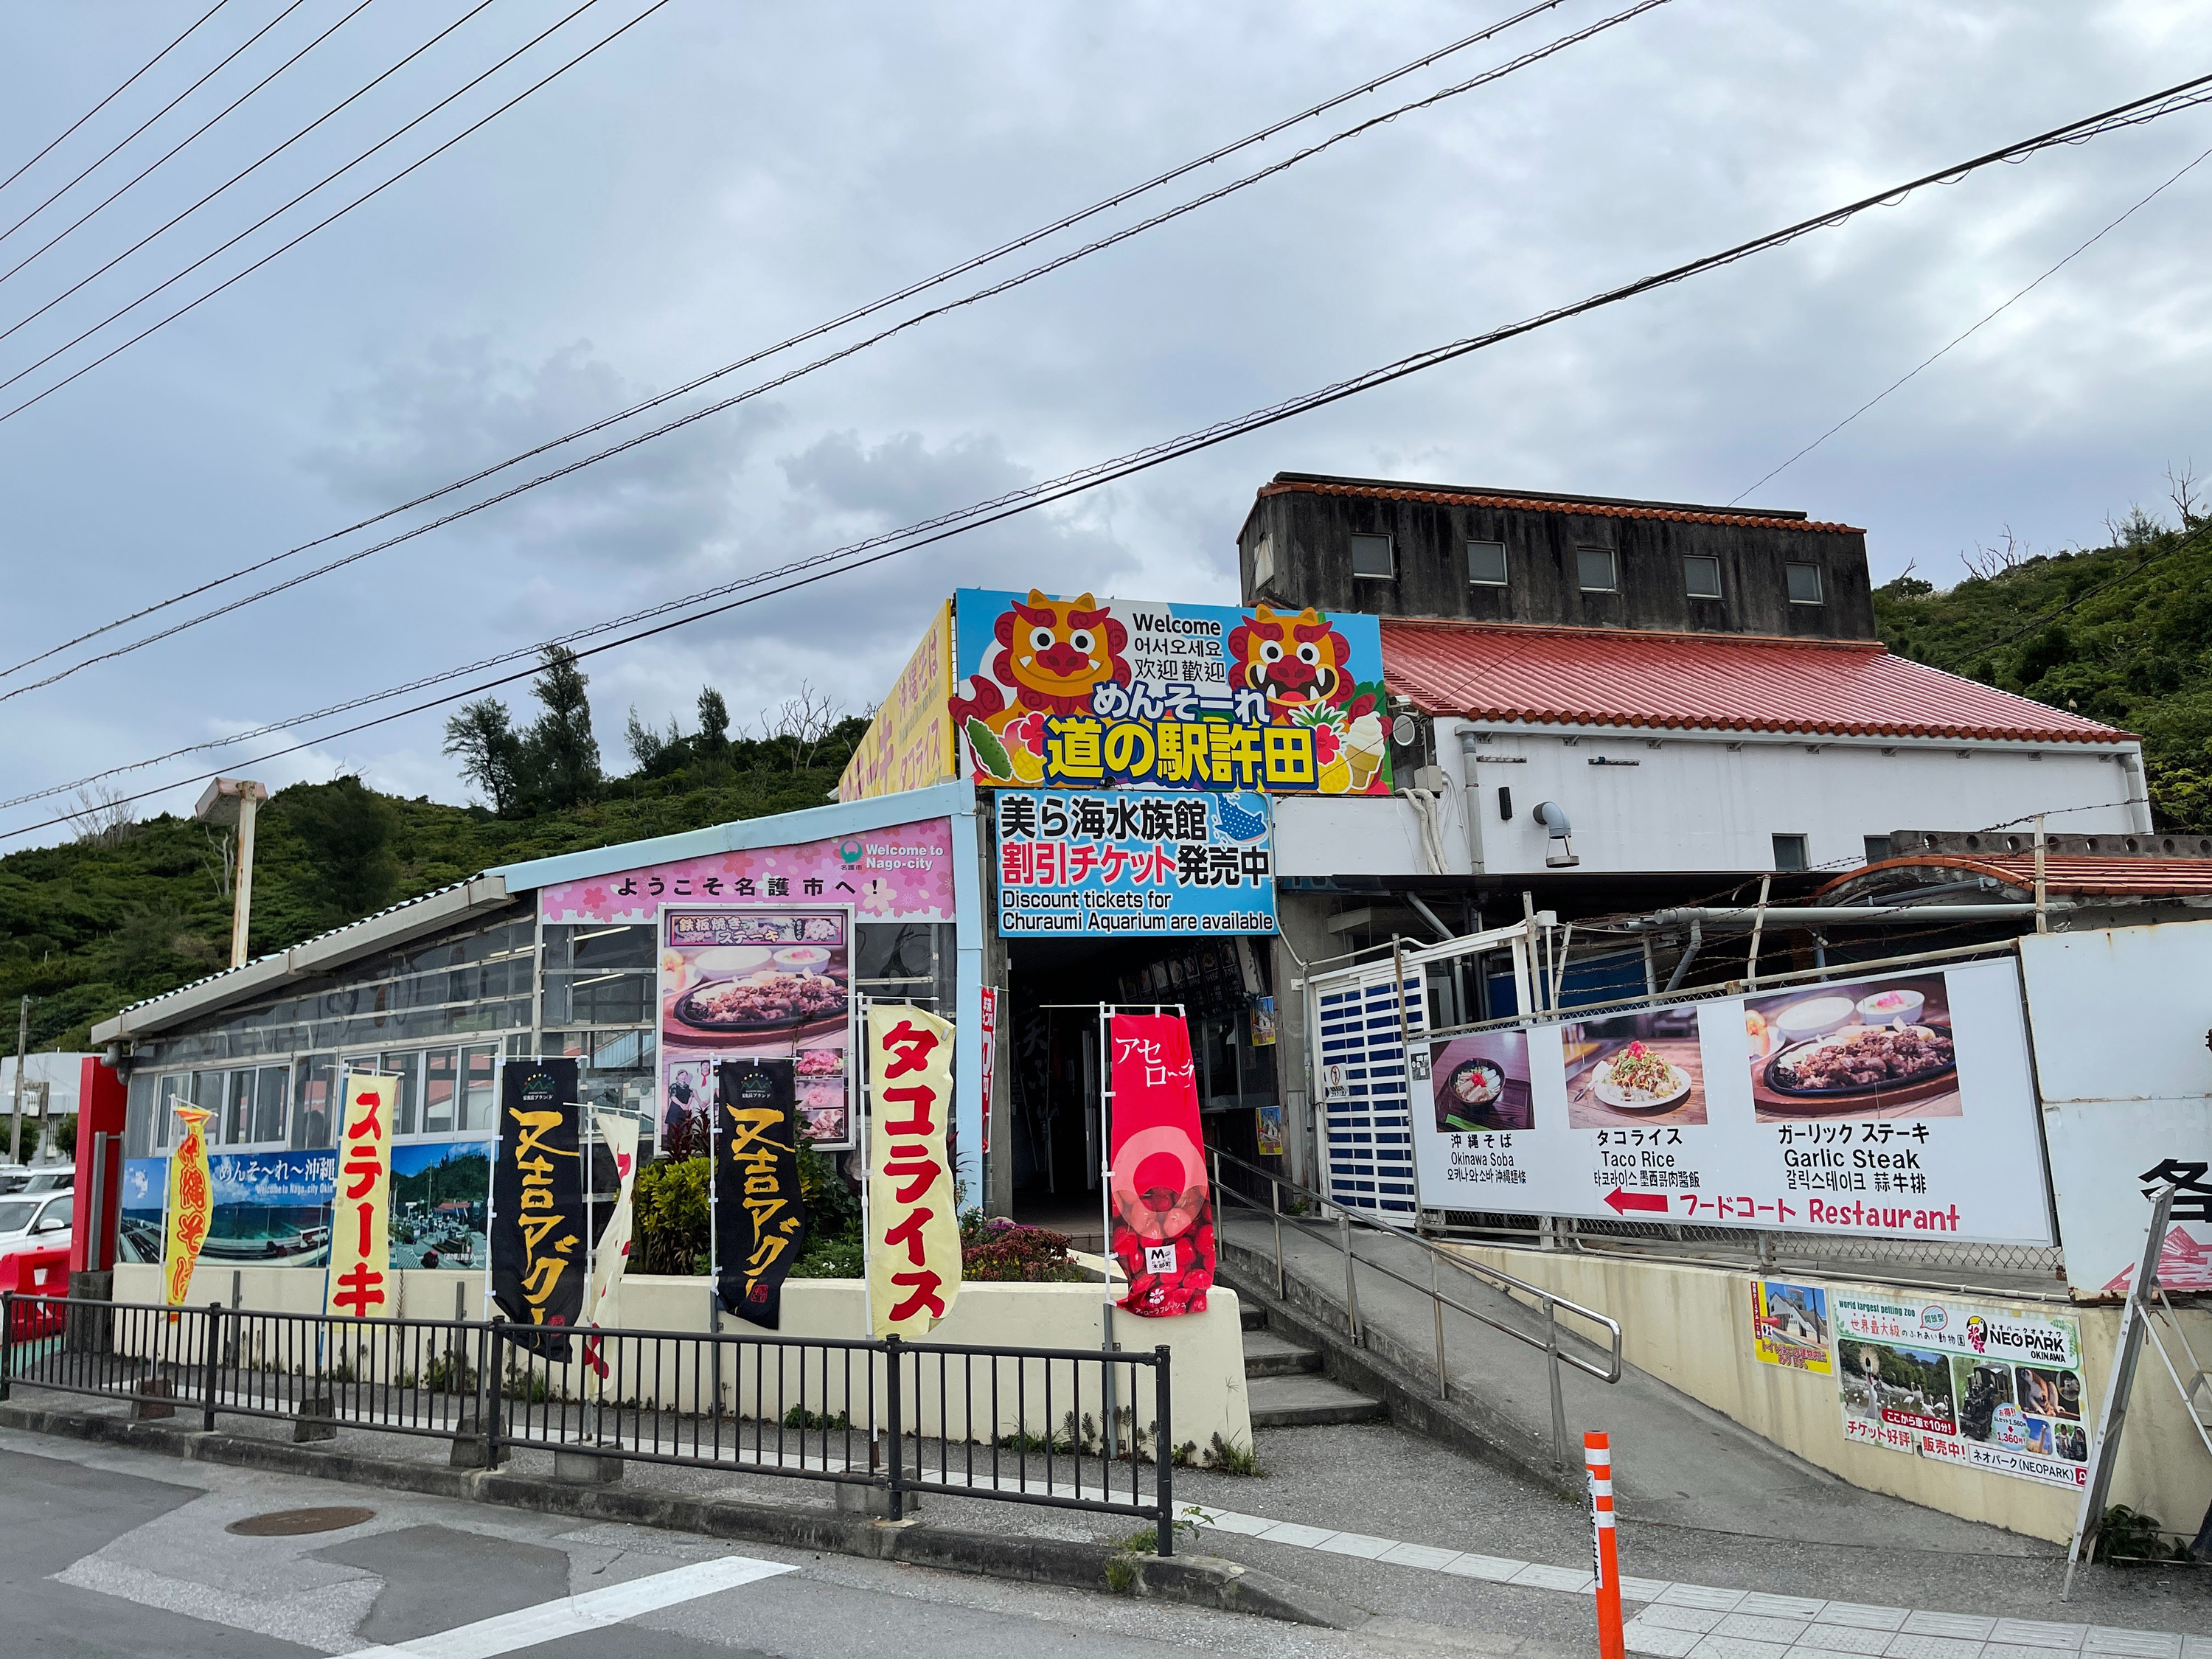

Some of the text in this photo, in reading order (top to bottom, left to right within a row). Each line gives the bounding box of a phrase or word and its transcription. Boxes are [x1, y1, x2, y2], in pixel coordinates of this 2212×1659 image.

[1133, 613, 1220, 636] Welcome
[1134, 637, 1222, 658] 어서오세요
[899, 622, 939, 722] 沖縄そば
[1135, 658, 1225, 683] 欢迎 歡迎
[1094, 684, 1270, 723] めんそーれ
[1047, 718, 1314, 785] 道の駅許田
[1002, 796, 1206, 840] 美ら海水族館
[866, 844, 944, 856] Welcome to
[866, 858, 933, 871] Nago-city
[1002, 842, 1269, 886] 割引チケット発売中
[1003, 891, 1172, 908] Discount tickets for
[679, 917, 742, 932] 鉄板焼き
[1003, 913, 1273, 933] Churaumi Aquarium are available
[719, 931, 779, 945] ステーキ
[1451, 1133, 1512, 1149] 沖縄そば
[1597, 1128, 1683, 1147] タコライス
[1778, 1122, 1930, 1144] ガーリック ステーキ
[1451, 1152, 1514, 1166] Okinawa Soba
[1601, 1151, 1674, 1167] Taco Rice
[1784, 1148, 1921, 1169] Garlic Steak
[883, 1020, 945, 1322] タコライス
[1447, 1167, 1494, 1183] 오키나와소바
[1594, 1169, 1638, 1187] 타코라이스
[256, 1183, 282, 1194] Welcome
[282, 1184, 288, 1194] to
[1786, 1169, 1927, 1194] 갈릭스테이크 蒜牛排
[333, 1092, 385, 1318] ステーキ
[1680, 1194, 1961, 1231] フードコート Restaurant
[1135, 1302, 1186, 1315] アローラフレッシュ
[1857, 1301, 1879, 1312] largest
[1881, 1306, 1902, 1317] petting
[1992, 1324, 2062, 1338] ネオパークオキナワ
[2031, 1351, 2066, 1363] OKINAWA
[1848, 1420, 1910, 1447] チケット好評
